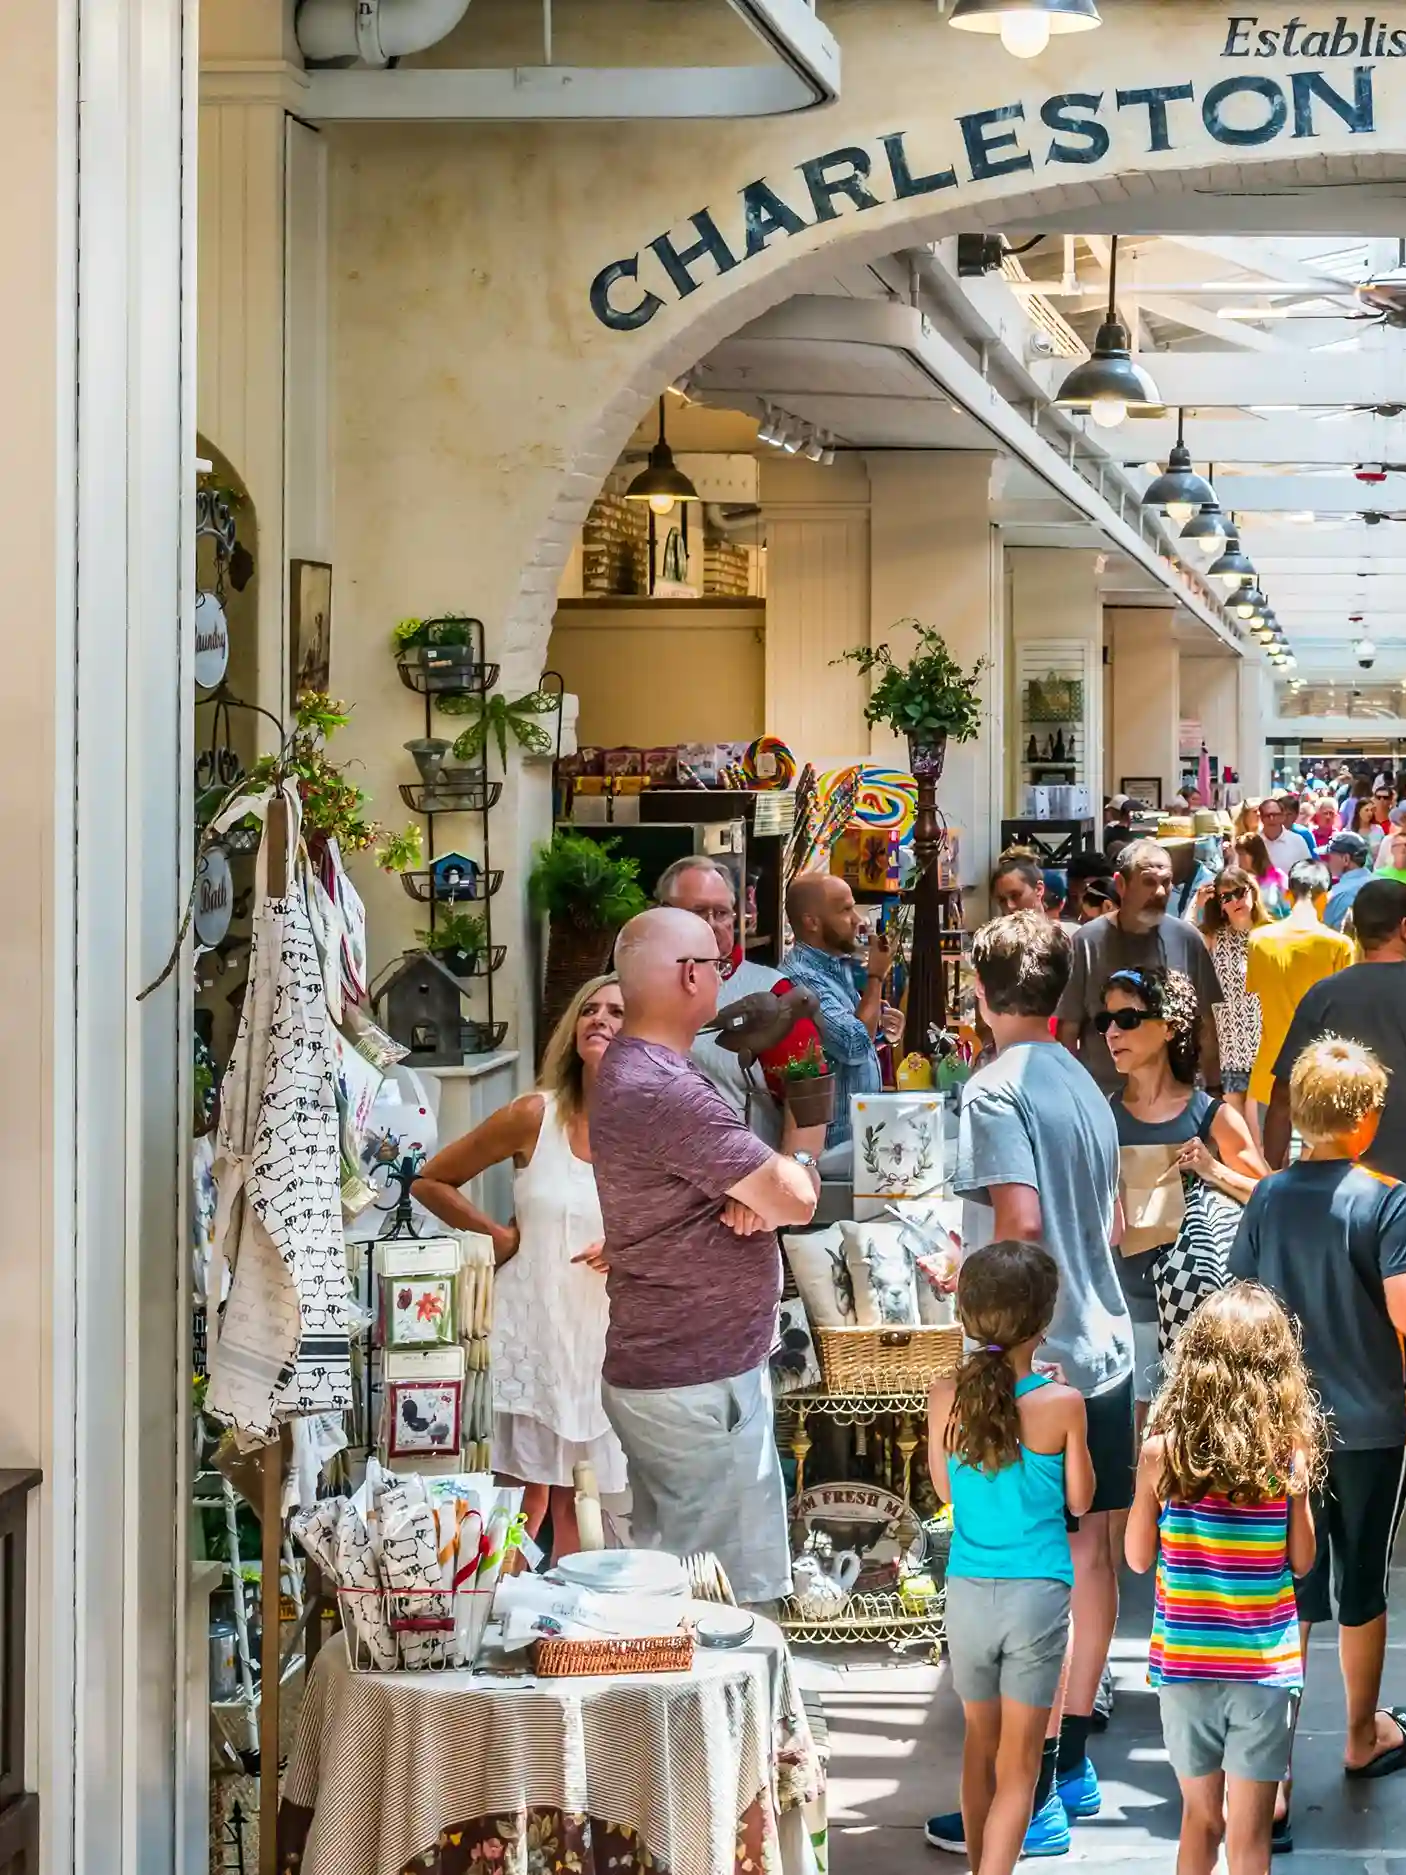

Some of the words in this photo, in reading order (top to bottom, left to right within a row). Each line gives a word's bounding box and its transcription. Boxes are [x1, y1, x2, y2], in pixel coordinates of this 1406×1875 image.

[589, 64, 1377, 332] CHARLESTON
[195, 621, 226, 660] aundry
[821, 1490, 880, 1507] FRESH
